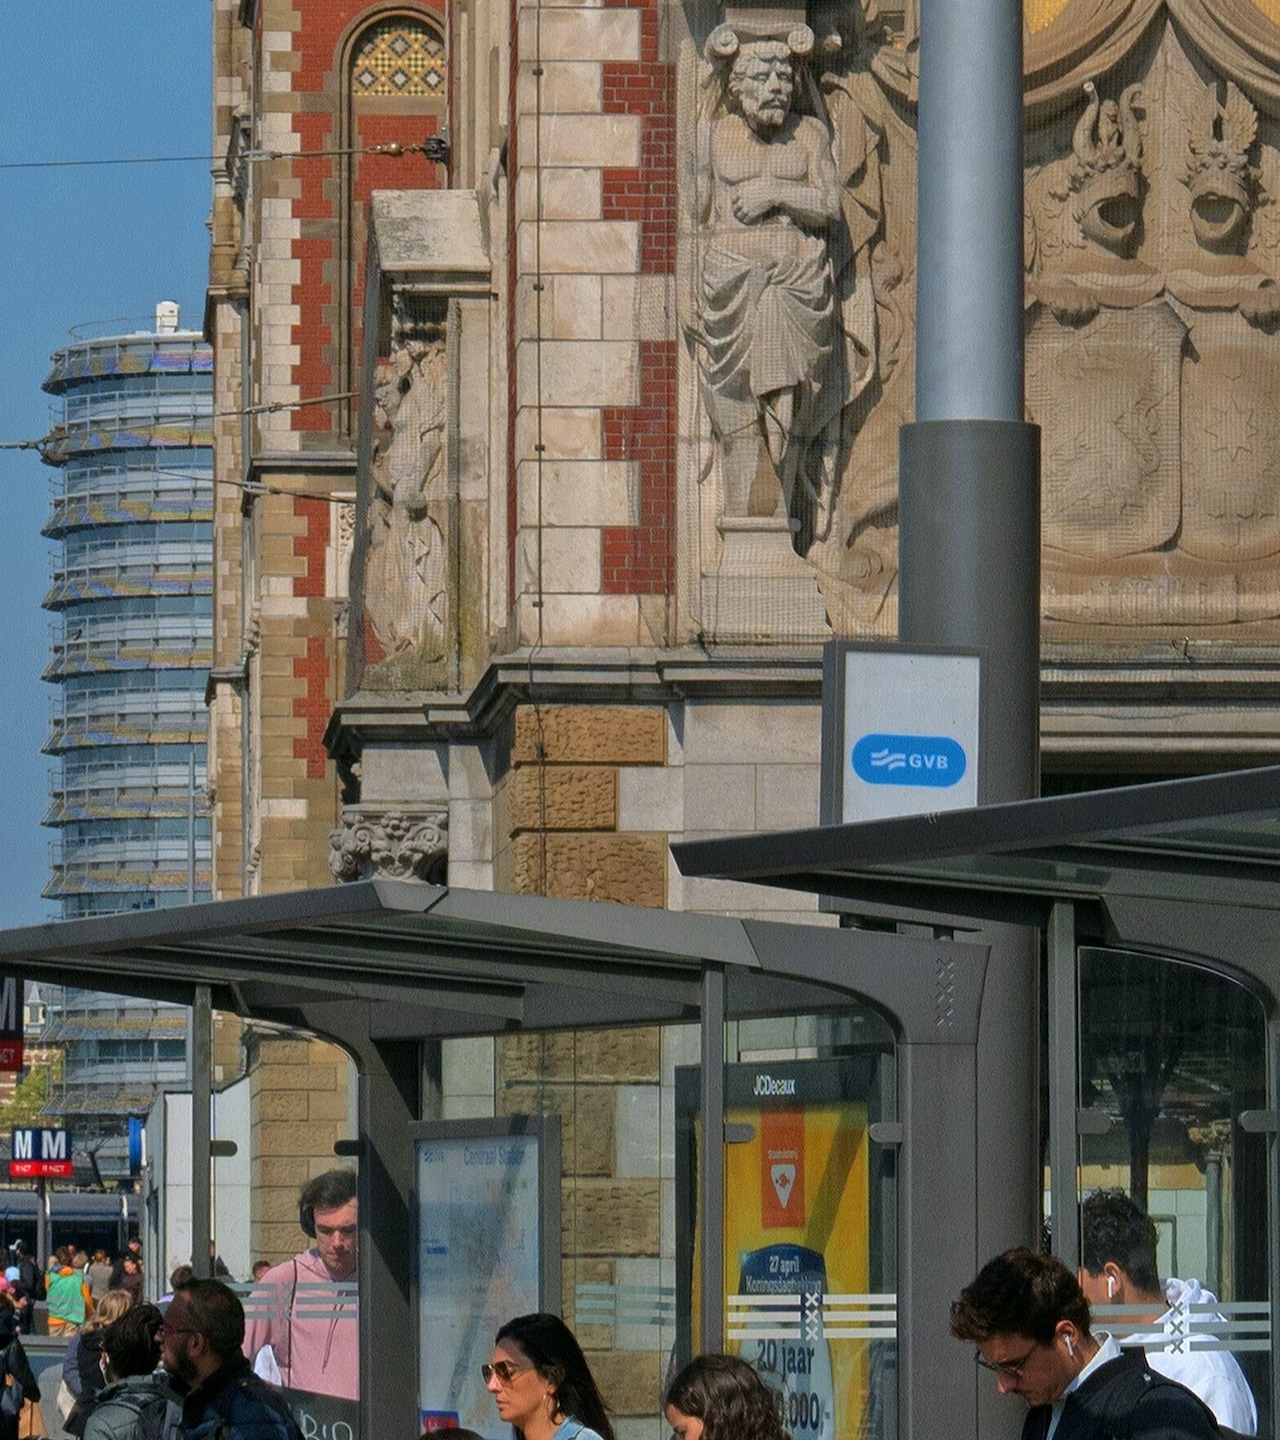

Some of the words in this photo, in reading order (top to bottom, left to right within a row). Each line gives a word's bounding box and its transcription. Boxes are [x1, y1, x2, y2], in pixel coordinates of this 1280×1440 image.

[908, 755, 949, 770] GVB
[753, 1075, 796, 1096] JCDecaux
[15, 1131, 32, 1160] M
[41, 1131, 66, 1160] M
[769, 1255, 779, 1273] 27
[780, 1255, 800, 1277] april
[757, 1338, 777, 1372] 20
[782, 1340, 815, 1383] jaar
